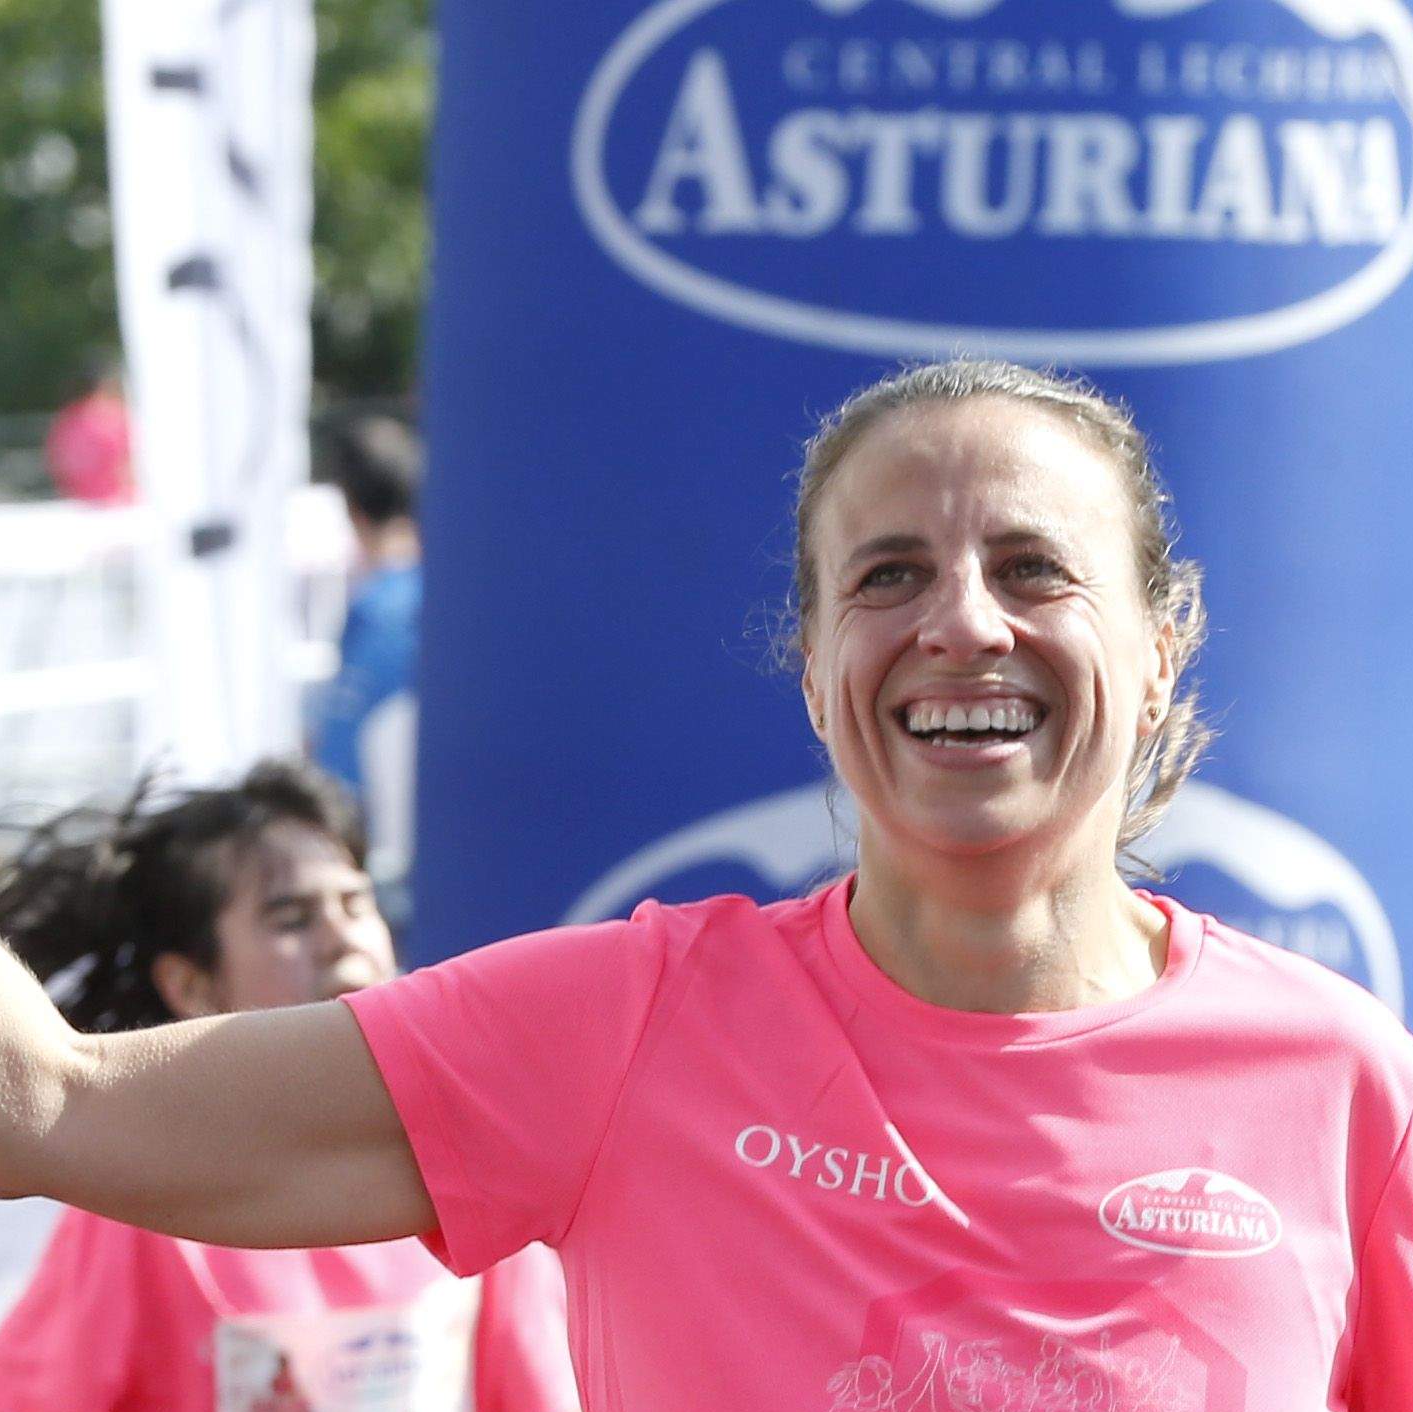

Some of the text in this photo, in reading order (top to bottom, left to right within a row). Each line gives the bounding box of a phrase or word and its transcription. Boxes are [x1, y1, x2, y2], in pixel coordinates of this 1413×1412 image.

[633, 47, 1404, 246] ASTURIANA
[735, 1124, 935, 1208] OYSHO
[1113, 1194, 1271, 1241] ASTURIANA
